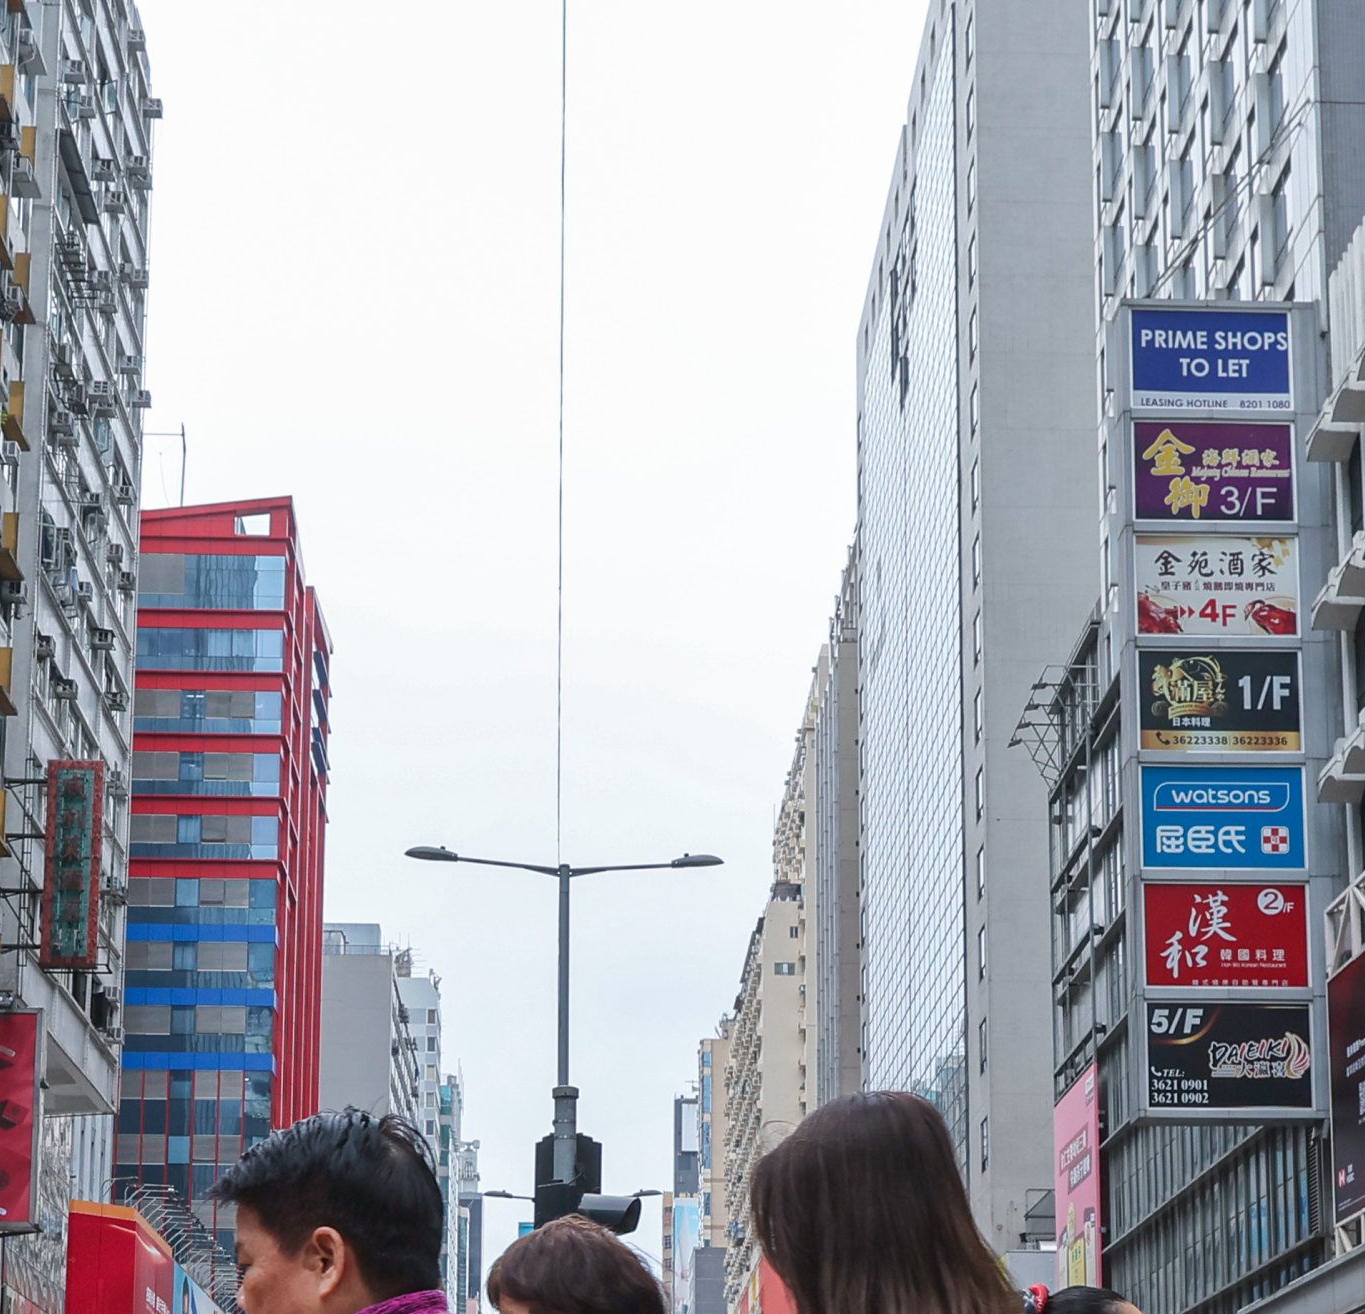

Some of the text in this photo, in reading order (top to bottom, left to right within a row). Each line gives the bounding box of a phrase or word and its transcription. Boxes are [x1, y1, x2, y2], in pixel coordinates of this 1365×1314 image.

[1141, 330, 1288, 352] PRIME SHOPS
[1180, 358, 1250, 378] TO LET
[1141, 398, 1291, 409] LEASING HOTLINE 8201 1080
[1142, 429, 1196, 476] 金
[1220, 486, 1277, 516] 3/F
[1154, 550, 1277, 577] 金苑酒家
[1198, 598, 1237, 627] 4F
[1238, 675, 1291, 710] 1/F
[1172, 717, 1211, 727] 日本料理
[1173, 735, 1288, 746] 36223338 36223336
[1172, 788, 1270, 804] watsons
[1156, 826, 1246, 854] 屈臣氏
[1258, 889, 1294, 914] 2/F
[1220, 948, 1285, 961] 韓國料理
[1151, 1008, 1203, 1034] 5/F
[1209, 1038, 1288, 1070] DAIEIKI
[1163, 1069, 1184, 1077] TEL:
[1151, 1080, 1208, 1090] 3621 0901
[1151, 1093, 1209, 1104] 3621 0902
